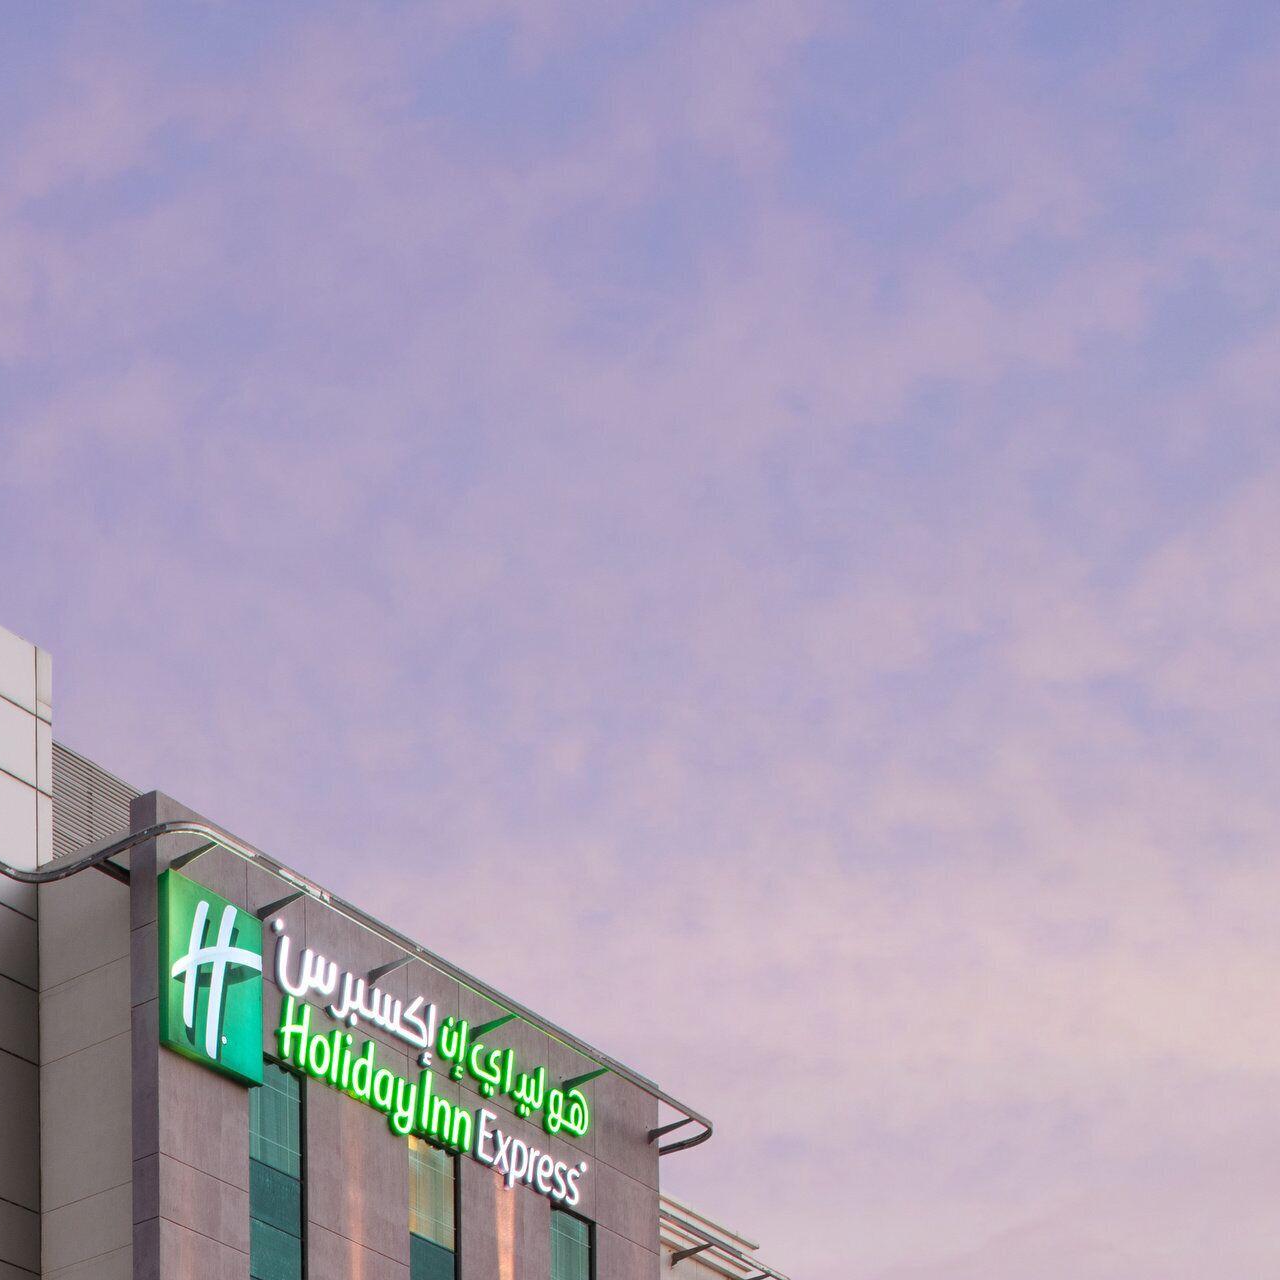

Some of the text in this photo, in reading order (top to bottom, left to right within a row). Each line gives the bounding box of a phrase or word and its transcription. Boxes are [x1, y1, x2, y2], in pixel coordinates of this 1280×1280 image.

[275, 934, 437, 1067] إكسبرس
[438, 1016, 470, 1081] إن
[275, 995, 580, 1206] Holiday Inn Express
